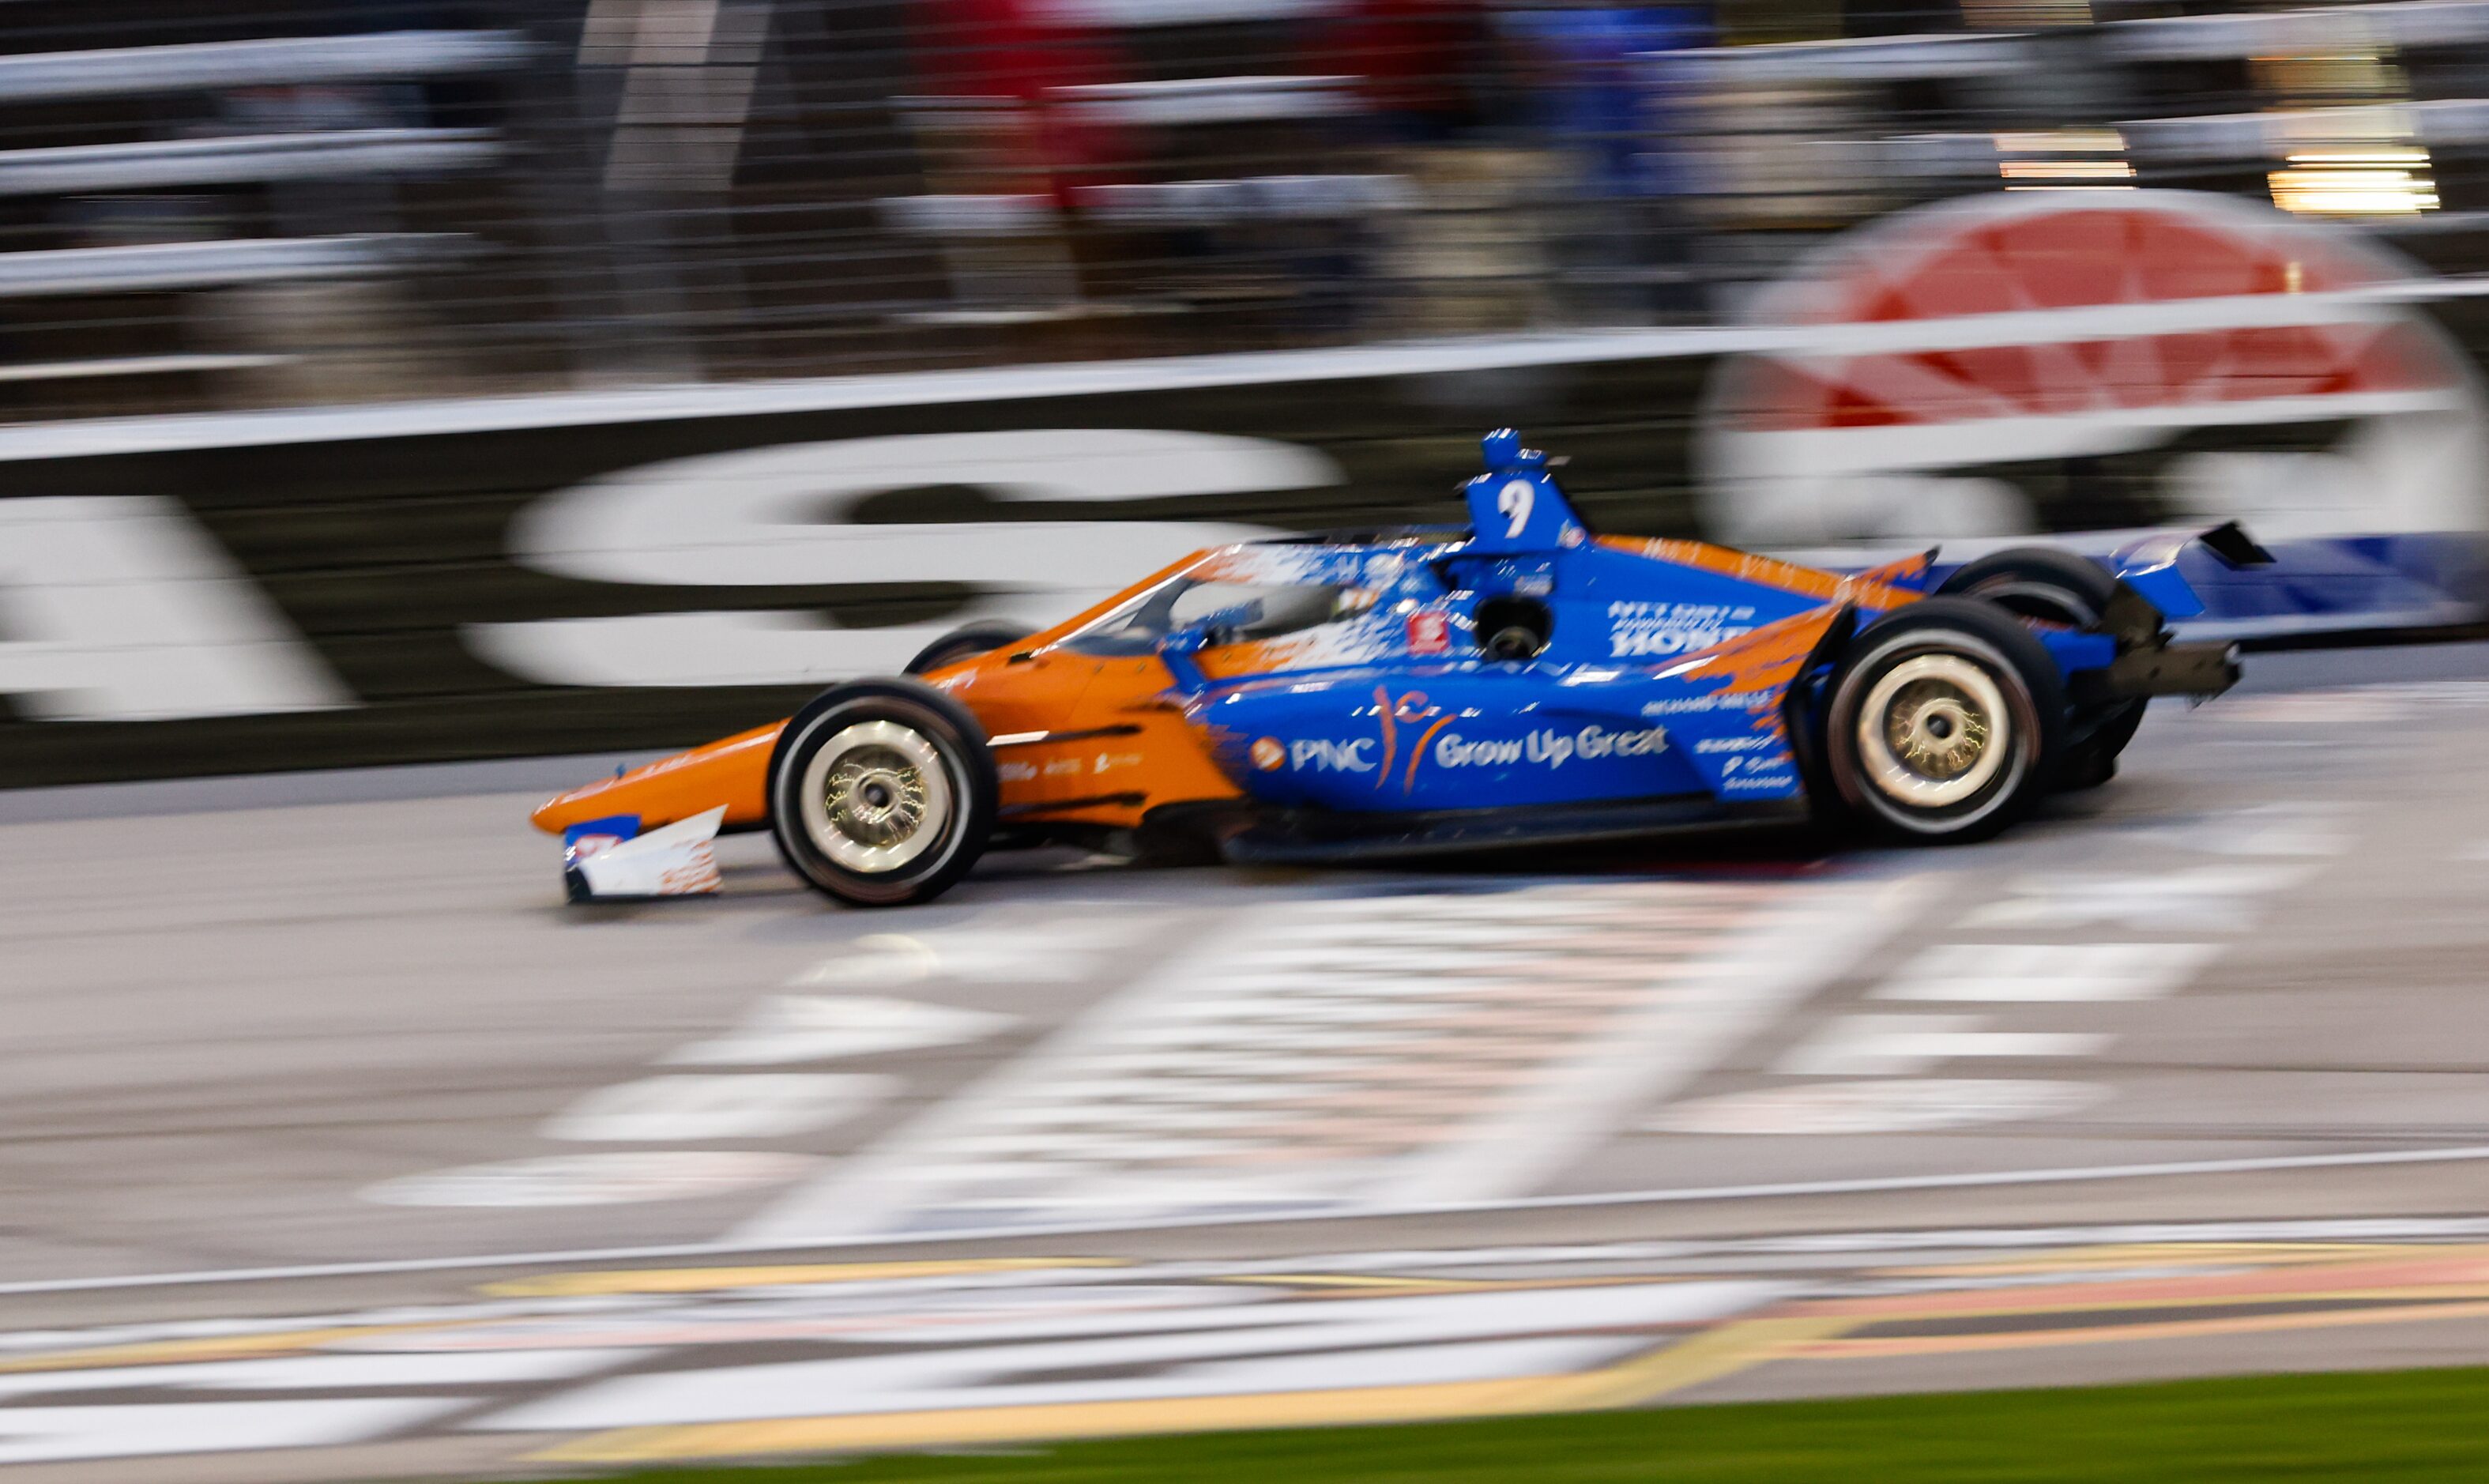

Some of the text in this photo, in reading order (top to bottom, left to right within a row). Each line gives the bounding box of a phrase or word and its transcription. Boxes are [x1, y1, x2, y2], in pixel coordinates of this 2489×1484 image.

[1498, 479, 1535, 539] 9
[1290, 737, 1376, 772] PNC
[1437, 733, 1523, 767] Grow
[1526, 728, 1575, 770] Up
[1575, 724, 1670, 758] Great
